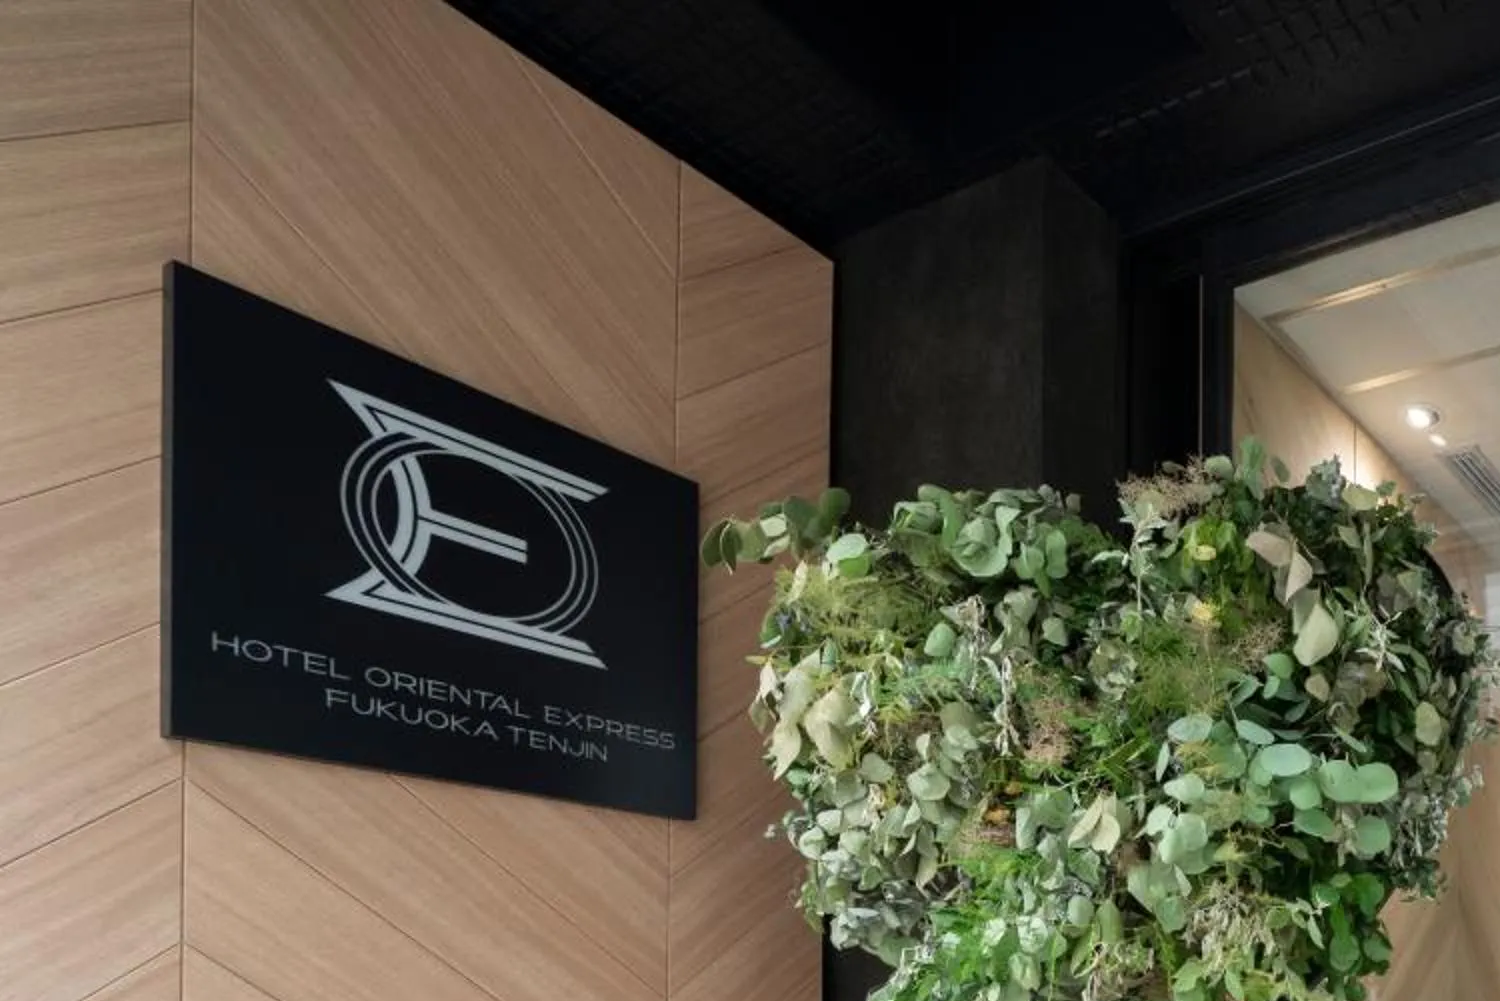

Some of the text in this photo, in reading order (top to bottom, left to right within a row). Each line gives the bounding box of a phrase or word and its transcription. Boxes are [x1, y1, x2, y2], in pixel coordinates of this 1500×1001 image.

[211, 630, 676, 750] HOTEL ORIENTAL EXPRESS
[325, 688, 608, 762] FUKUOKA TENJIN
